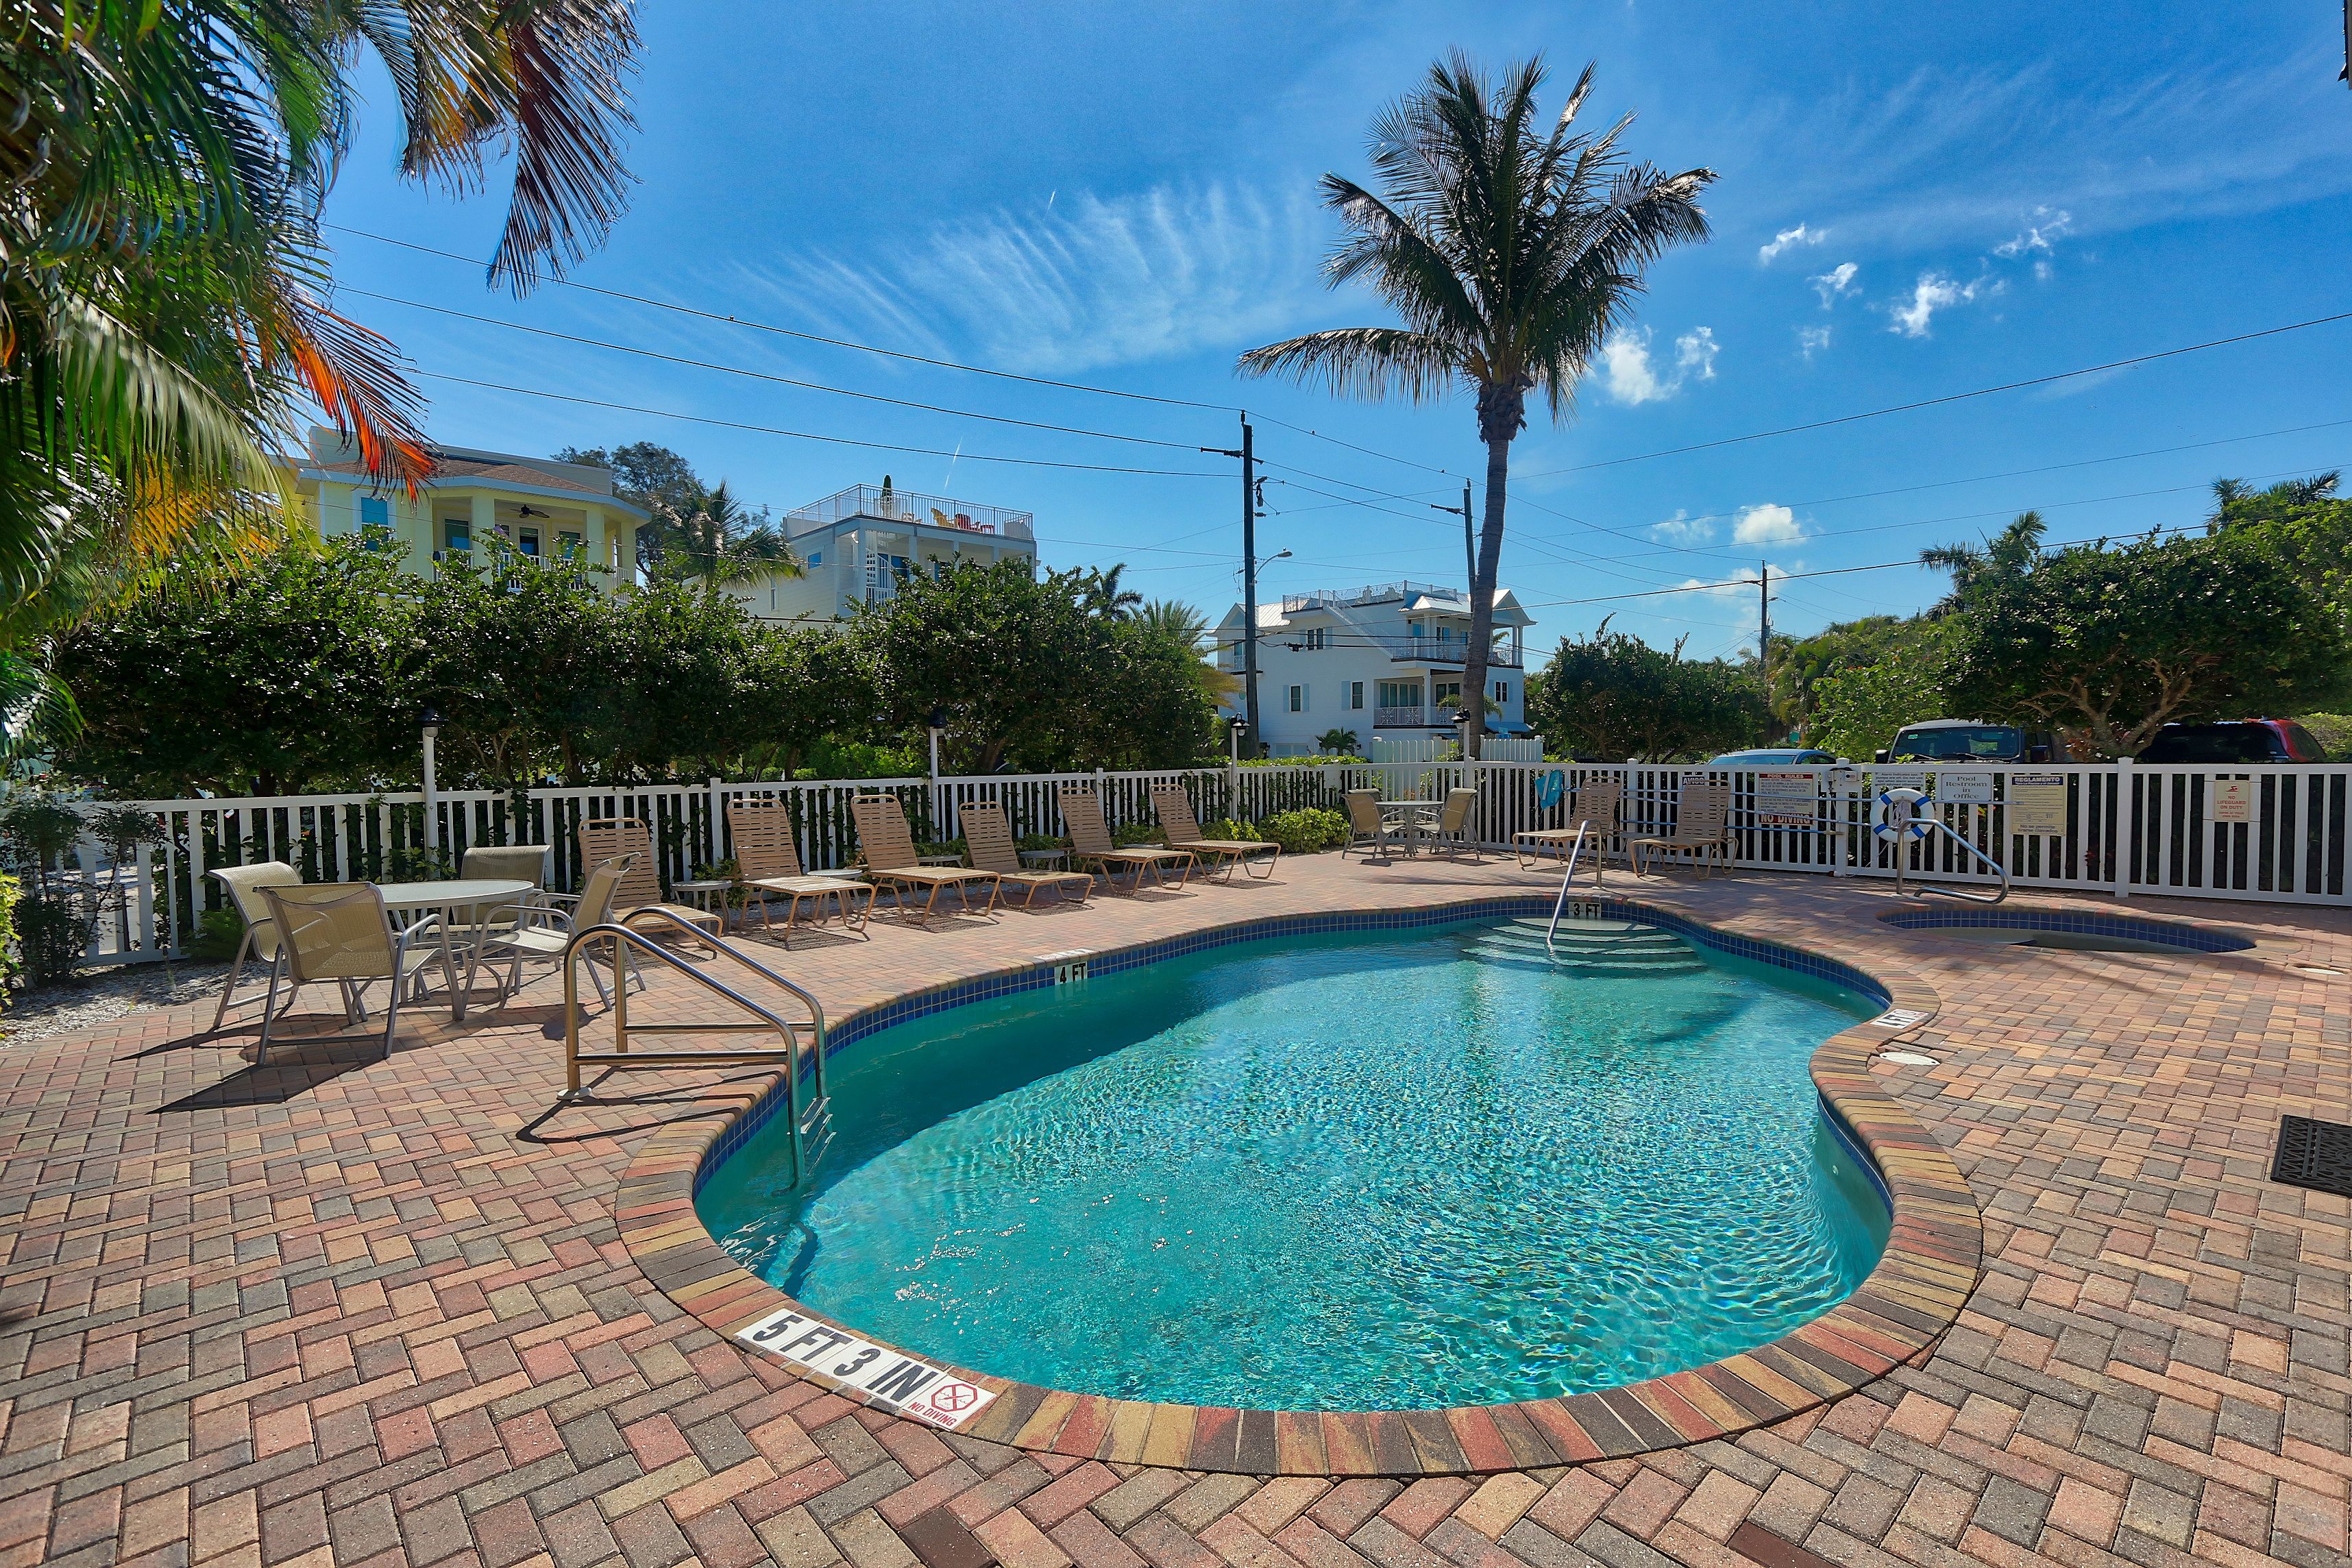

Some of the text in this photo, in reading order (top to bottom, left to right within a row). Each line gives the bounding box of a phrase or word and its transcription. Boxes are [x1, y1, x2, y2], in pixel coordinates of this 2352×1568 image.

[1761, 813, 1810, 824] NO DIVING
[1573, 903, 1600, 917] 3 FT
[1059, 962, 1086, 983] 4 FT
[752, 1314, 938, 1403] 5 FT 3 IN
[907, 1401, 925, 1412] NO
[922, 1408, 958, 1427] DIVING
